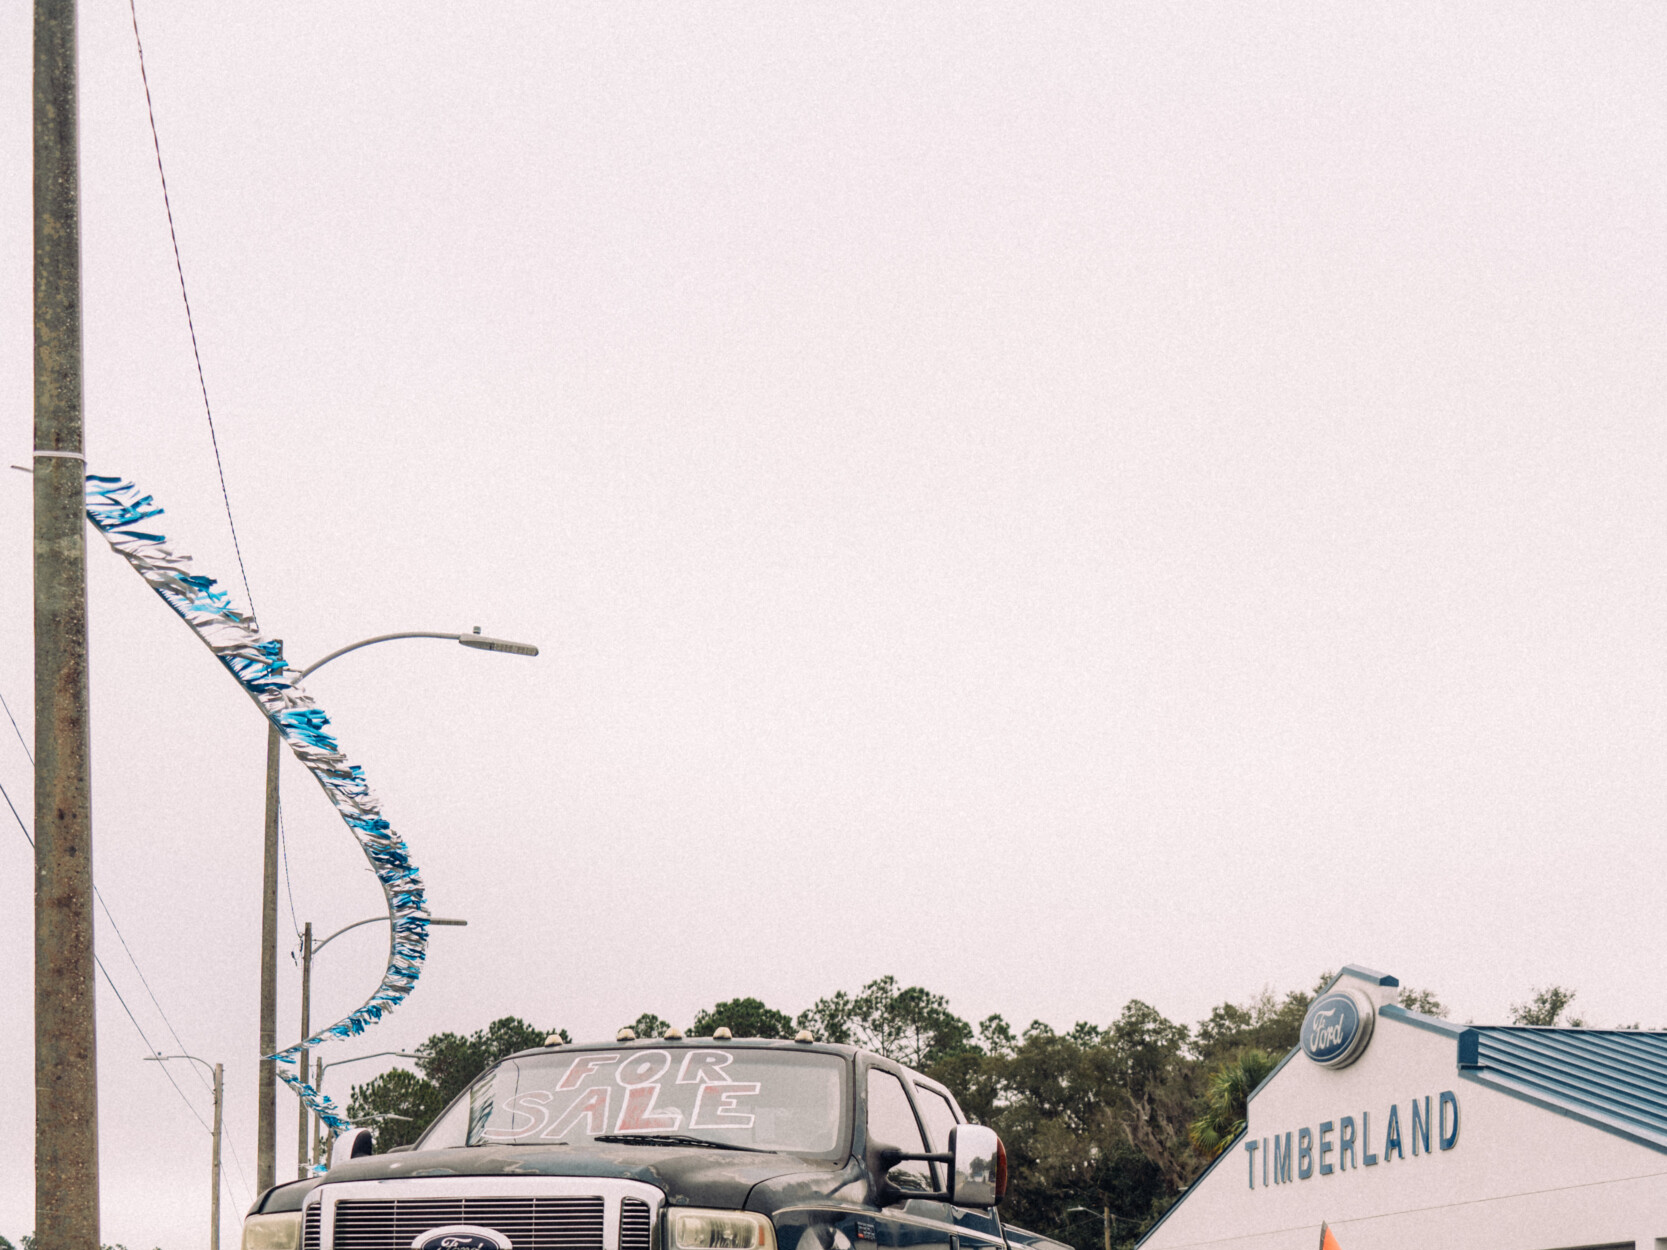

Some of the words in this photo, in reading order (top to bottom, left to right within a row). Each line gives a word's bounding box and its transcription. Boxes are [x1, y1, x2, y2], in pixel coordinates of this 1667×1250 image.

[1309, 1007, 1344, 1052] Ford
[555, 1049, 733, 1092] FOR
[481, 1082, 761, 1139] SALE
[1244, 1090, 1461, 1189] TIMBERLAND
